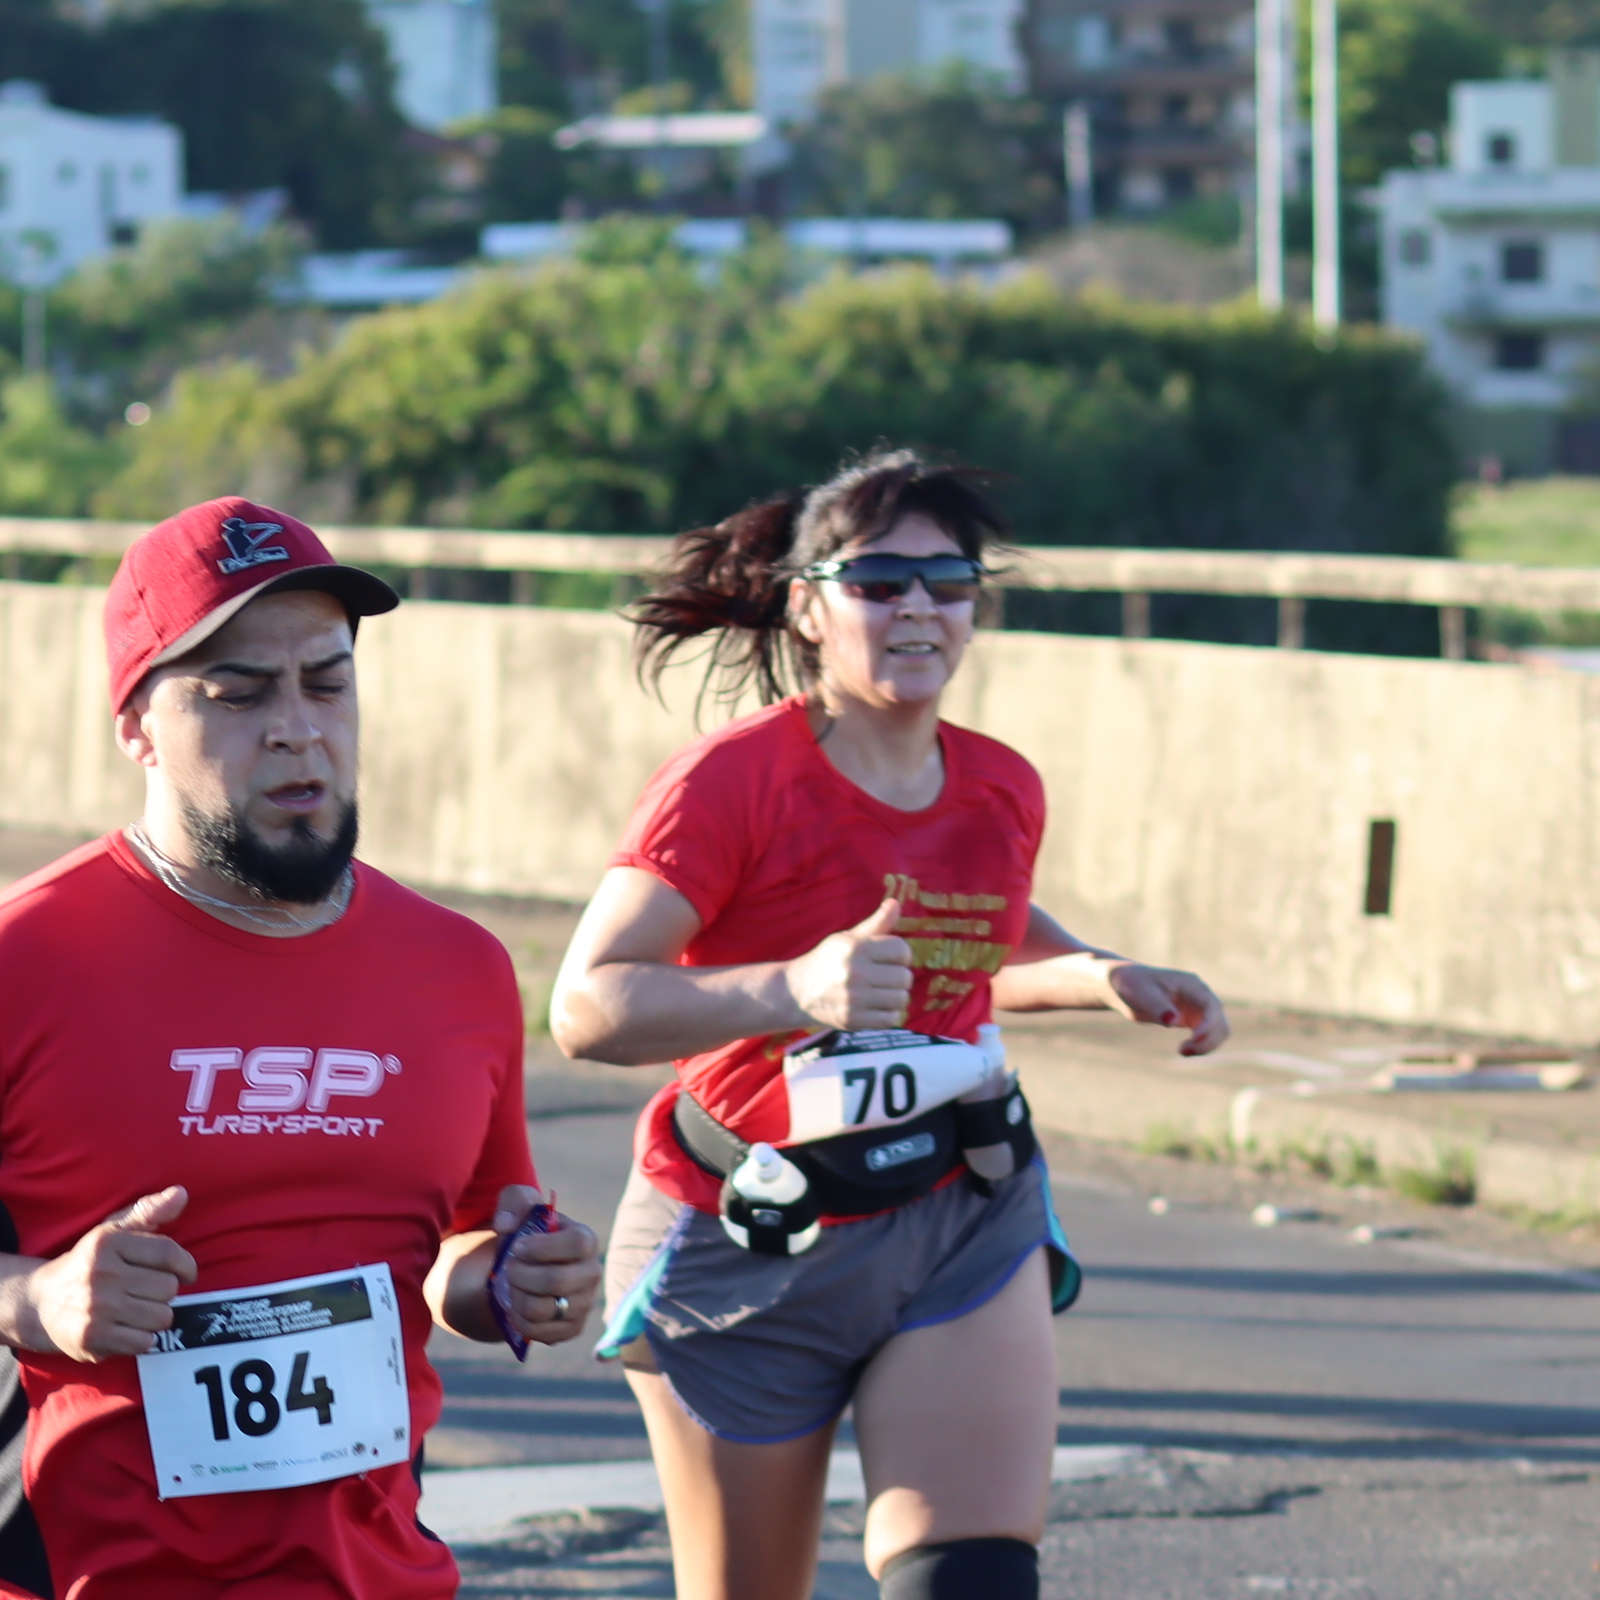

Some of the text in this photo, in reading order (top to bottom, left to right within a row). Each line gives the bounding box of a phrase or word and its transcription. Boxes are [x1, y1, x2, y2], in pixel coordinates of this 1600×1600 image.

[178, 1114, 385, 1138] TURBYSPORT
[843, 1062, 918, 1126] 70
[193, 1351, 335, 1441] 184
